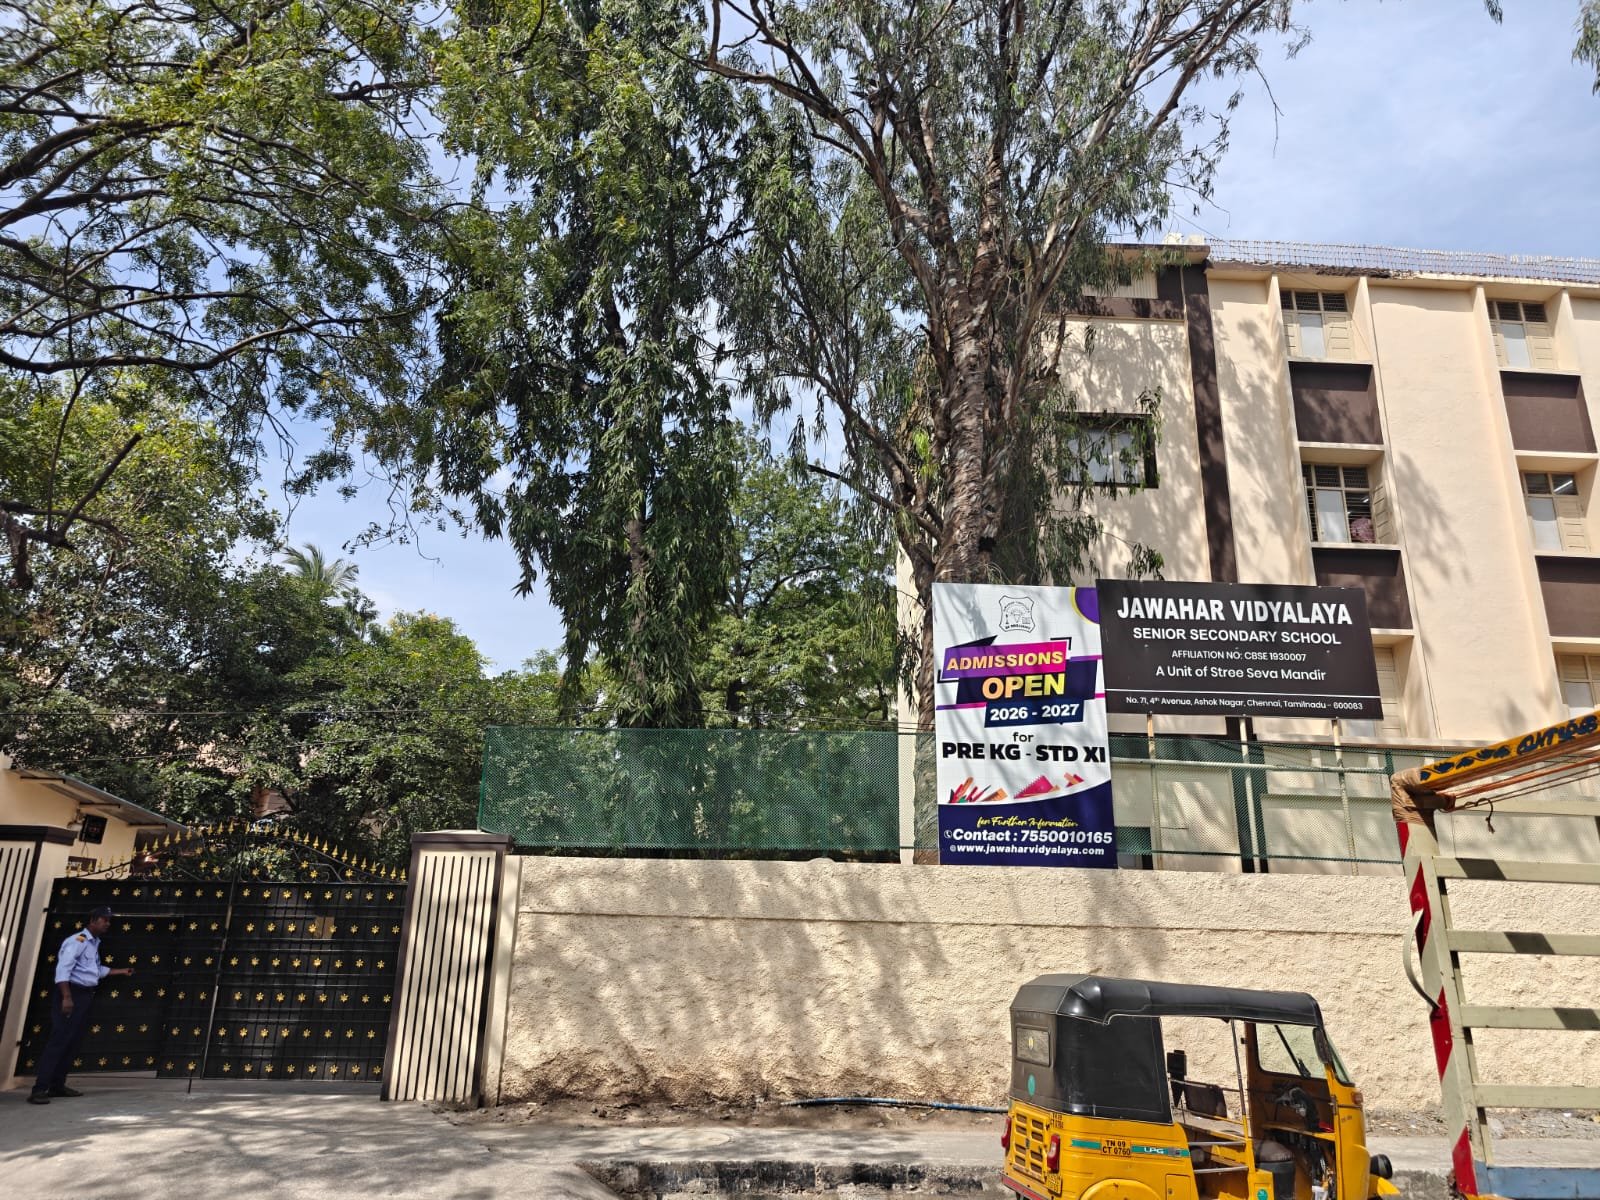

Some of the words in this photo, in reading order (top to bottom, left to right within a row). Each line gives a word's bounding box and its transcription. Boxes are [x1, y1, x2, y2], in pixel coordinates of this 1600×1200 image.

[1117, 597, 1225, 620] JAWAHAR
[1230, 600, 1353, 625] VIDYALAYA
[1133, 627, 1186, 640] SENIOR
[1190, 629, 1277, 642] SECONDARY
[1281, 632, 1342, 645] SCHOOL
[946, 651, 1064, 671] ADMISSIONS
[1171, 650, 1224, 659] AFFILIATION
[1226, 651, 1243, 660] NO:
[1244, 652, 1268, 661] CBSE
[1269, 653, 1307, 661] 1930007
[1155, 666, 1165, 676] A
[1167, 665, 1192, 677] Unit
[1195, 666, 1208, 677] of
[1210, 667, 1244, 678] Stree
[1246, 668, 1278, 679] Seva
[1281, 669, 1326, 680] Mandir
[982, 673, 1066, 700] OPEN
[1161, 697, 1193, 706] Avenue,
[1194, 698, 1218, 706] Ashok
[1219, 699, 1246, 708] Nagar,
[1246, 699, 1283, 708] Chennai,
[1283, 701, 1327, 709] Tamilnadu
[1333, 702, 1363, 710] 600083
[990, 707, 1028, 721] 2026
[1041, 703, 1080, 718] 2027
[1012, 731, 1034, 743] for
[942, 742, 985, 759] PRE
[990, 744, 1021, 760] KG
[1036, 745, 1079, 762] STD
[991, 815, 1028, 827] Further
[953, 828, 1011, 841] Contact
[1020, 830, 1113, 844] 7550010165
[957, 843, 1105, 856] www.jawaharvidyalaya.com
[1117, 1140, 1126, 1148] 09
